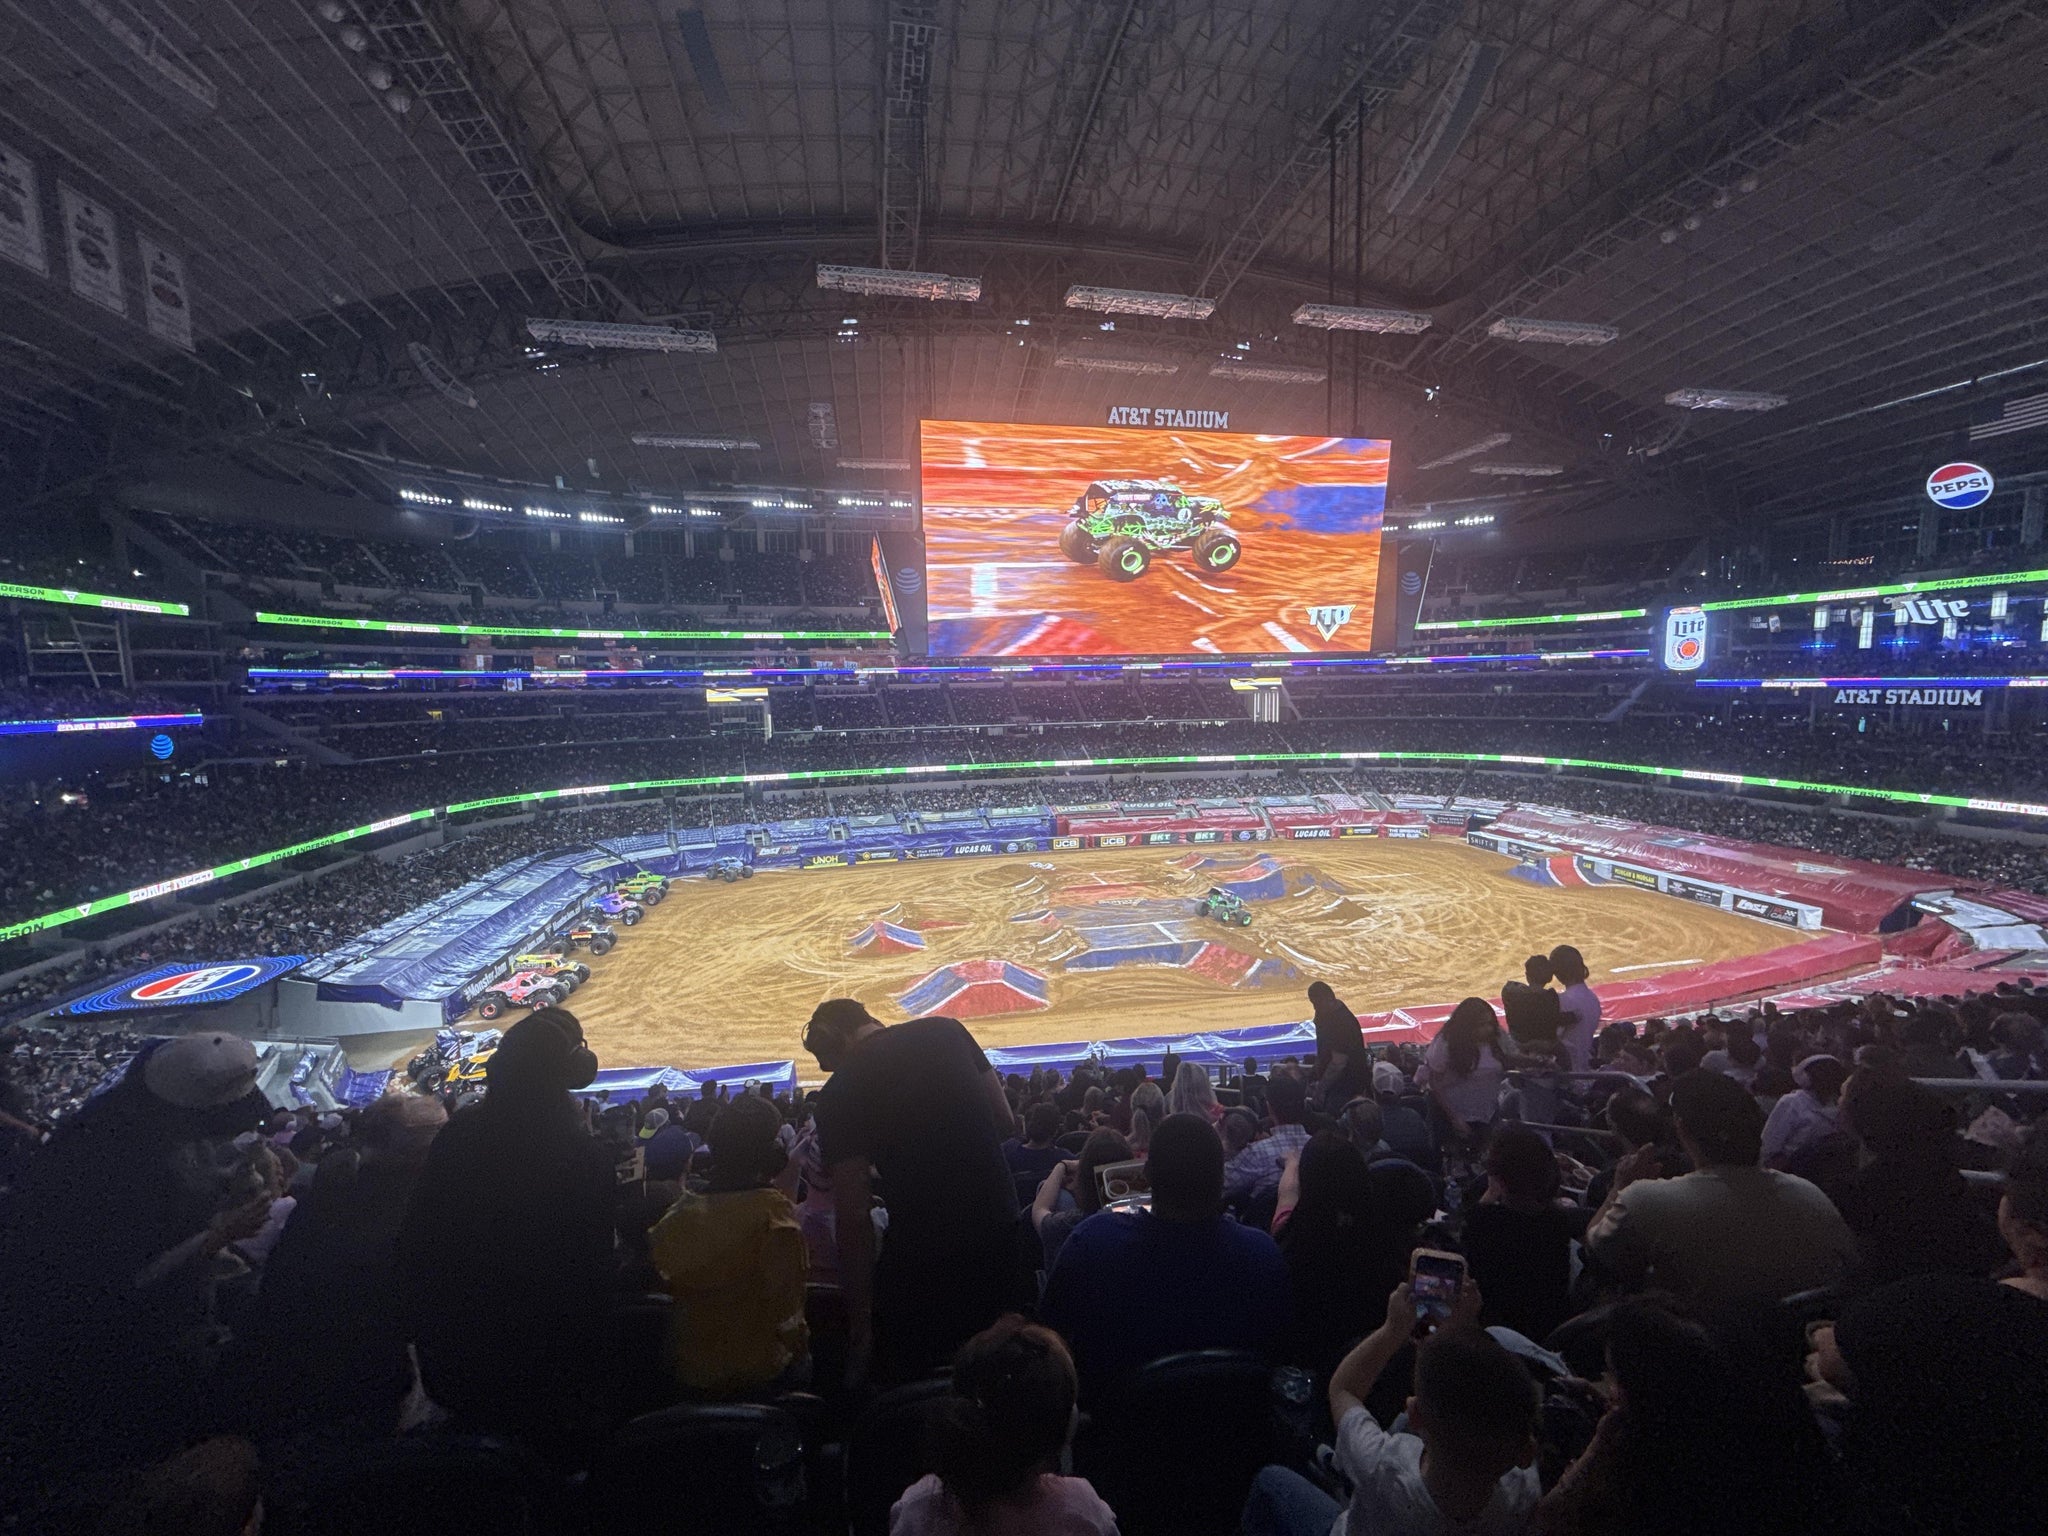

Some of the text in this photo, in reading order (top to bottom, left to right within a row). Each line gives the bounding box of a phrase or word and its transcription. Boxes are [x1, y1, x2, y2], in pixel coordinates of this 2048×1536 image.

[1108, 406, 1229, 429] AT&T STADIUM
[1931, 477, 1989, 495] PEPSI
[1935, 573, 2027, 587] ADAM ANDERSON
[1901, 599, 1970, 625] Lite
[301, 618, 343, 626] ANDERSON
[1673, 620, 1705, 637] Lite
[1834, 689, 1983, 706] AT&T STADIUM
[1799, 784, 1828, 793] ADAM
[464, 801, 480, 809] ADAM
[1150, 833, 1171, 841] BKT
[1195, 832, 1216, 840] BKT
[1295, 829, 1331, 838] LUCAS OIL
[1054, 839, 1078, 848] JCB
[1103, 836, 1124, 846] JCB
[270, 838, 335, 862] ADAM ANDERSON
[955, 844, 993, 854] LUCAS OIL
[812, 855, 839, 865] UNOH
[1614, 868, 1632, 878] MORGAN
